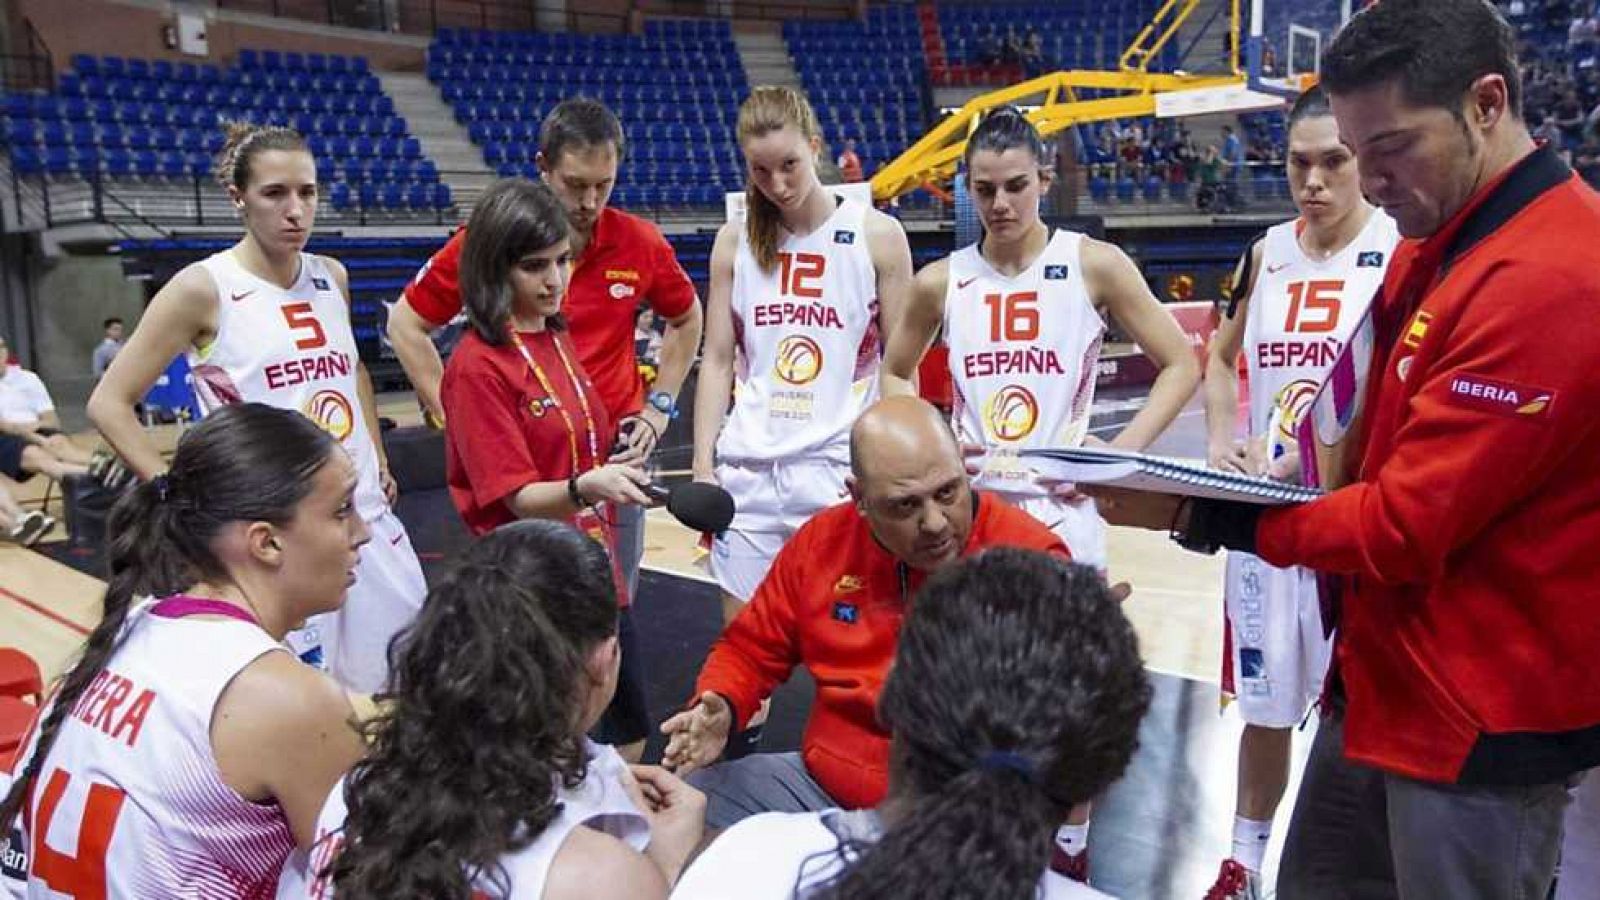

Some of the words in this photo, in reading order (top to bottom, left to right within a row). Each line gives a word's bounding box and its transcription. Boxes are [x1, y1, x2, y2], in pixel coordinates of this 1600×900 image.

[777, 252, 826, 298] 12
[281, 302, 327, 350] 5
[755, 302, 844, 329] ESPAÑA
[984, 291, 1040, 342] 16
[1284, 280, 1345, 333] 15
[265, 350, 352, 390] ESPAÑ
[964, 346, 1065, 379] ESPAÑA
[1257, 337, 1343, 369] ESPAÑ
[1451, 380, 1519, 405] IBERIA
[73, 670, 157, 746] RERA
